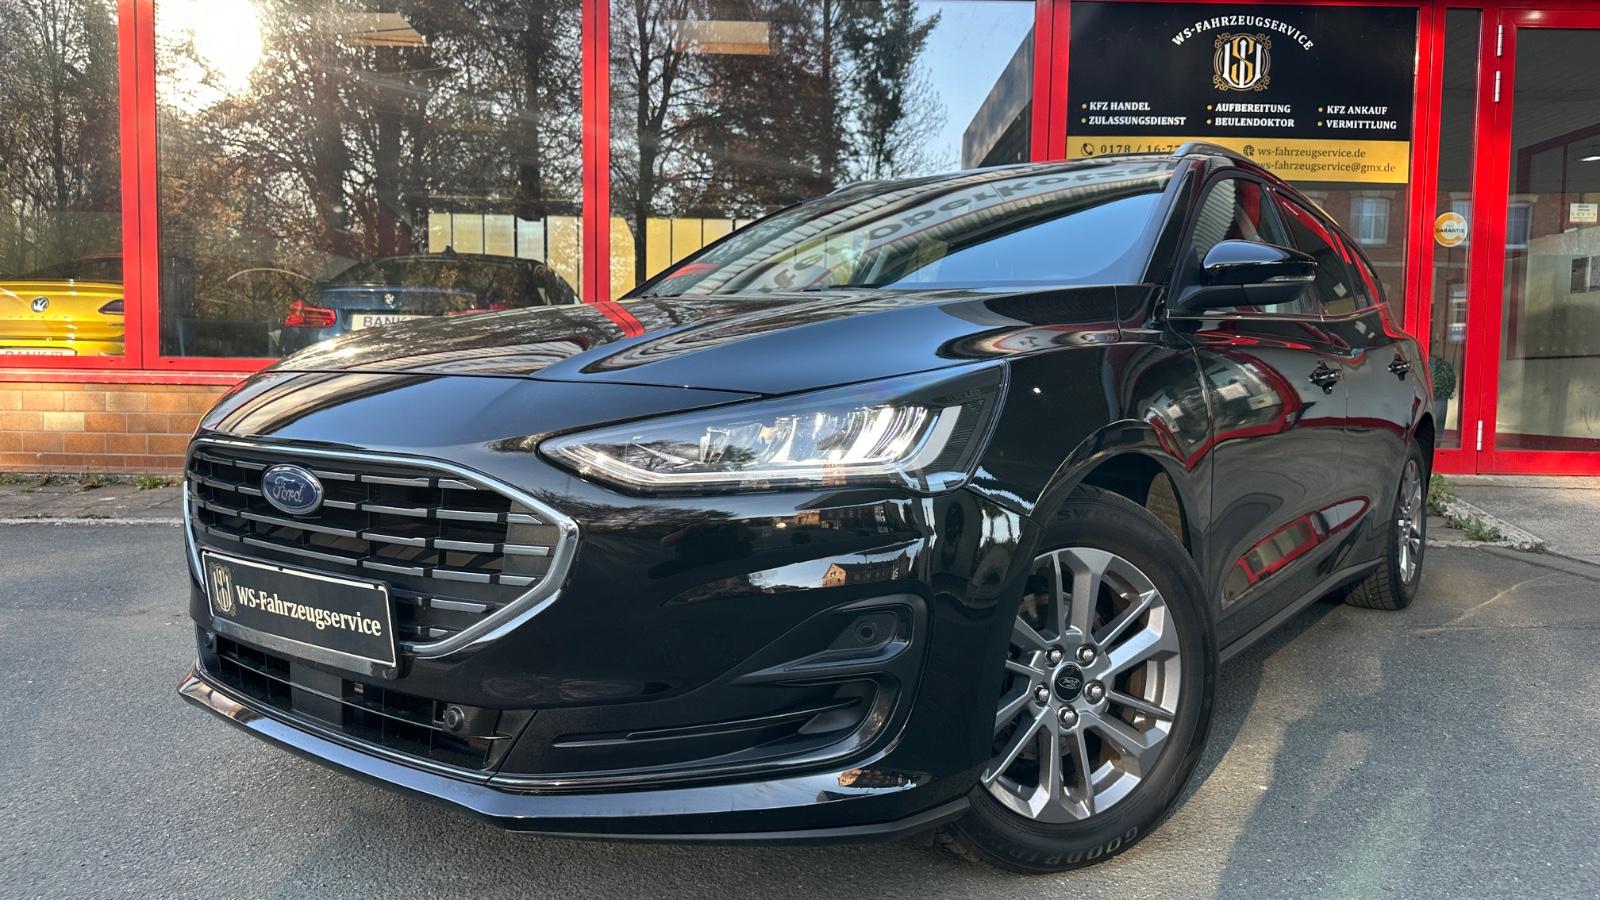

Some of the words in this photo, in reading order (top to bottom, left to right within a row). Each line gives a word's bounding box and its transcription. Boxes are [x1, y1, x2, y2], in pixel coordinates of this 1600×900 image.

[1172, 15, 1314, 51] WS-FAHRZEUGSERVICE
[1089, 101, 1108, 111] KFZ
[1110, 101, 1150, 111] HANDEL
[1215, 103, 1291, 113] AUFBEREITUNG
[1327, 105, 1346, 115] KFZ
[1347, 106, 1387, 115] ANKAUF
[1088, 116, 1186, 126] ZULASSUNGSDIENST
[1214, 117, 1295, 127] BEULENDOKTOR
[1326, 119, 1397, 130] VERMITTLUNG
[1100, 144, 1131, 154] 0178
[1258, 146, 1366, 159] ws-fahrzeugservice.de
[1257, 160, 1396, 174] ws-fahrzeugservice@gmx.de
[272, 475, 306, 503] Ford
[235, 584, 382, 637] WS-Fahrzeugservice
